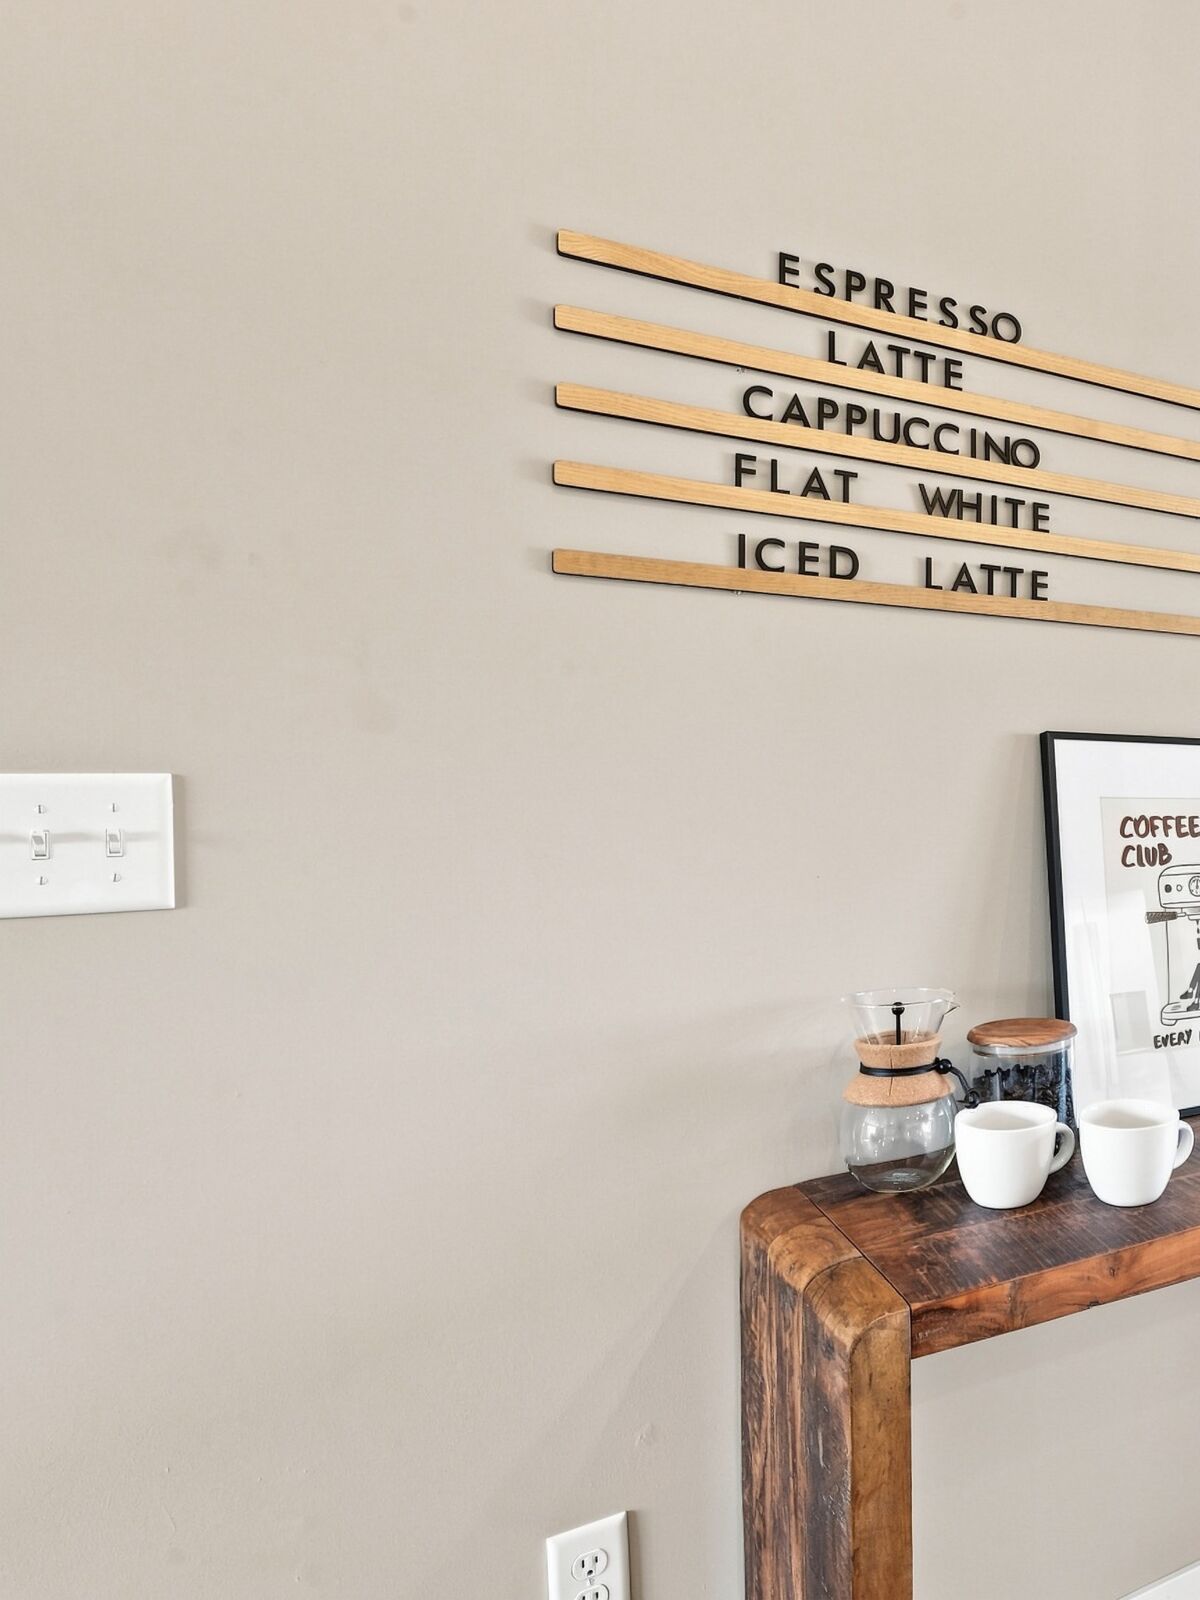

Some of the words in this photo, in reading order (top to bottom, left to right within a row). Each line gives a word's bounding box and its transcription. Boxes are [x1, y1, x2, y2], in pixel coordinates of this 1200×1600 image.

[778, 252, 1022, 345] ESPRESSO
[827, 330, 963, 392] LATTE
[742, 385, 1041, 470] CAPPUCCINO
[735, 453, 858, 504] FLAT
[918, 483, 1050, 533] WHITE
[738, 533, 860, 580] ICED
[925, 557, 1049, 601] LATTE
[1121, 843, 1173, 868] CLUB
[1153, 1029, 1192, 1049] EVERY
